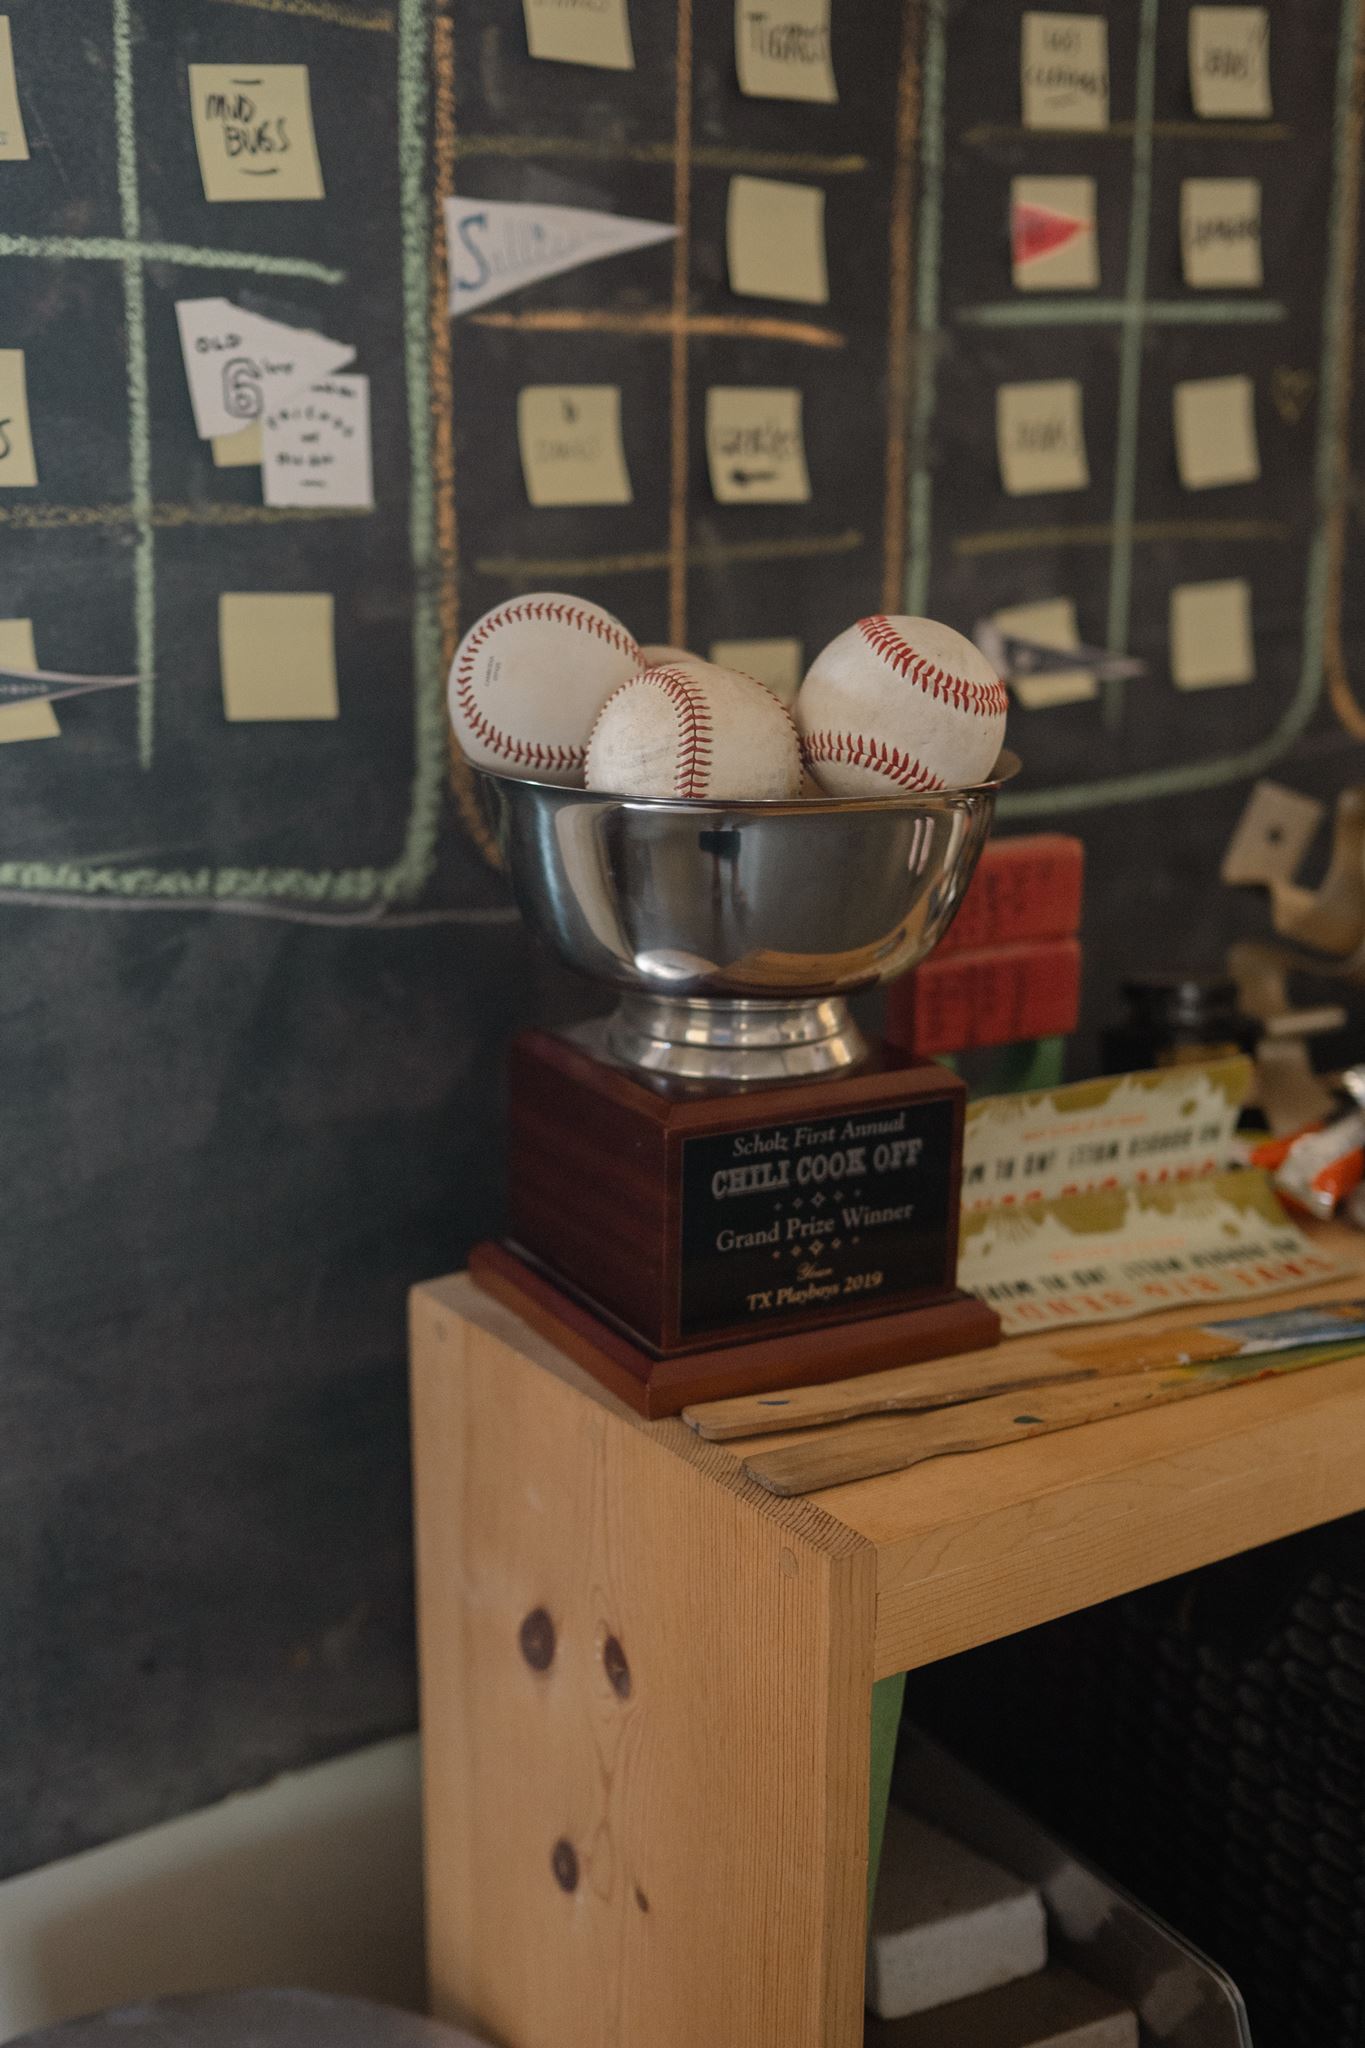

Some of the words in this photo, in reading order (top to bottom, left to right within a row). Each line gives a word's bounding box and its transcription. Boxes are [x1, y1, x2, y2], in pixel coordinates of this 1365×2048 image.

[205, 94, 258, 123] MUD
[225, 117, 290, 156] BUGS
[195, 333, 243, 354] OLD
[222, 357, 264, 419] 6
[732, 1132, 788, 1158] Scholz
[794, 1126, 837, 1149] First
[840, 1112, 905, 1140] Annual
[711, 1158, 790, 1199] CHILI
[795, 1147, 867, 1185] COOK
[873, 1138, 924, 1171] OFF
[715, 1220, 780, 1251] Grand
[786, 1216, 835, 1241] Prize
[842, 1203, 914, 1229] Winner
[747, 1290, 773, 1311] TX
[776, 1283, 840, 1305] Playboys
[843, 1271, 883, 1294] 2019
